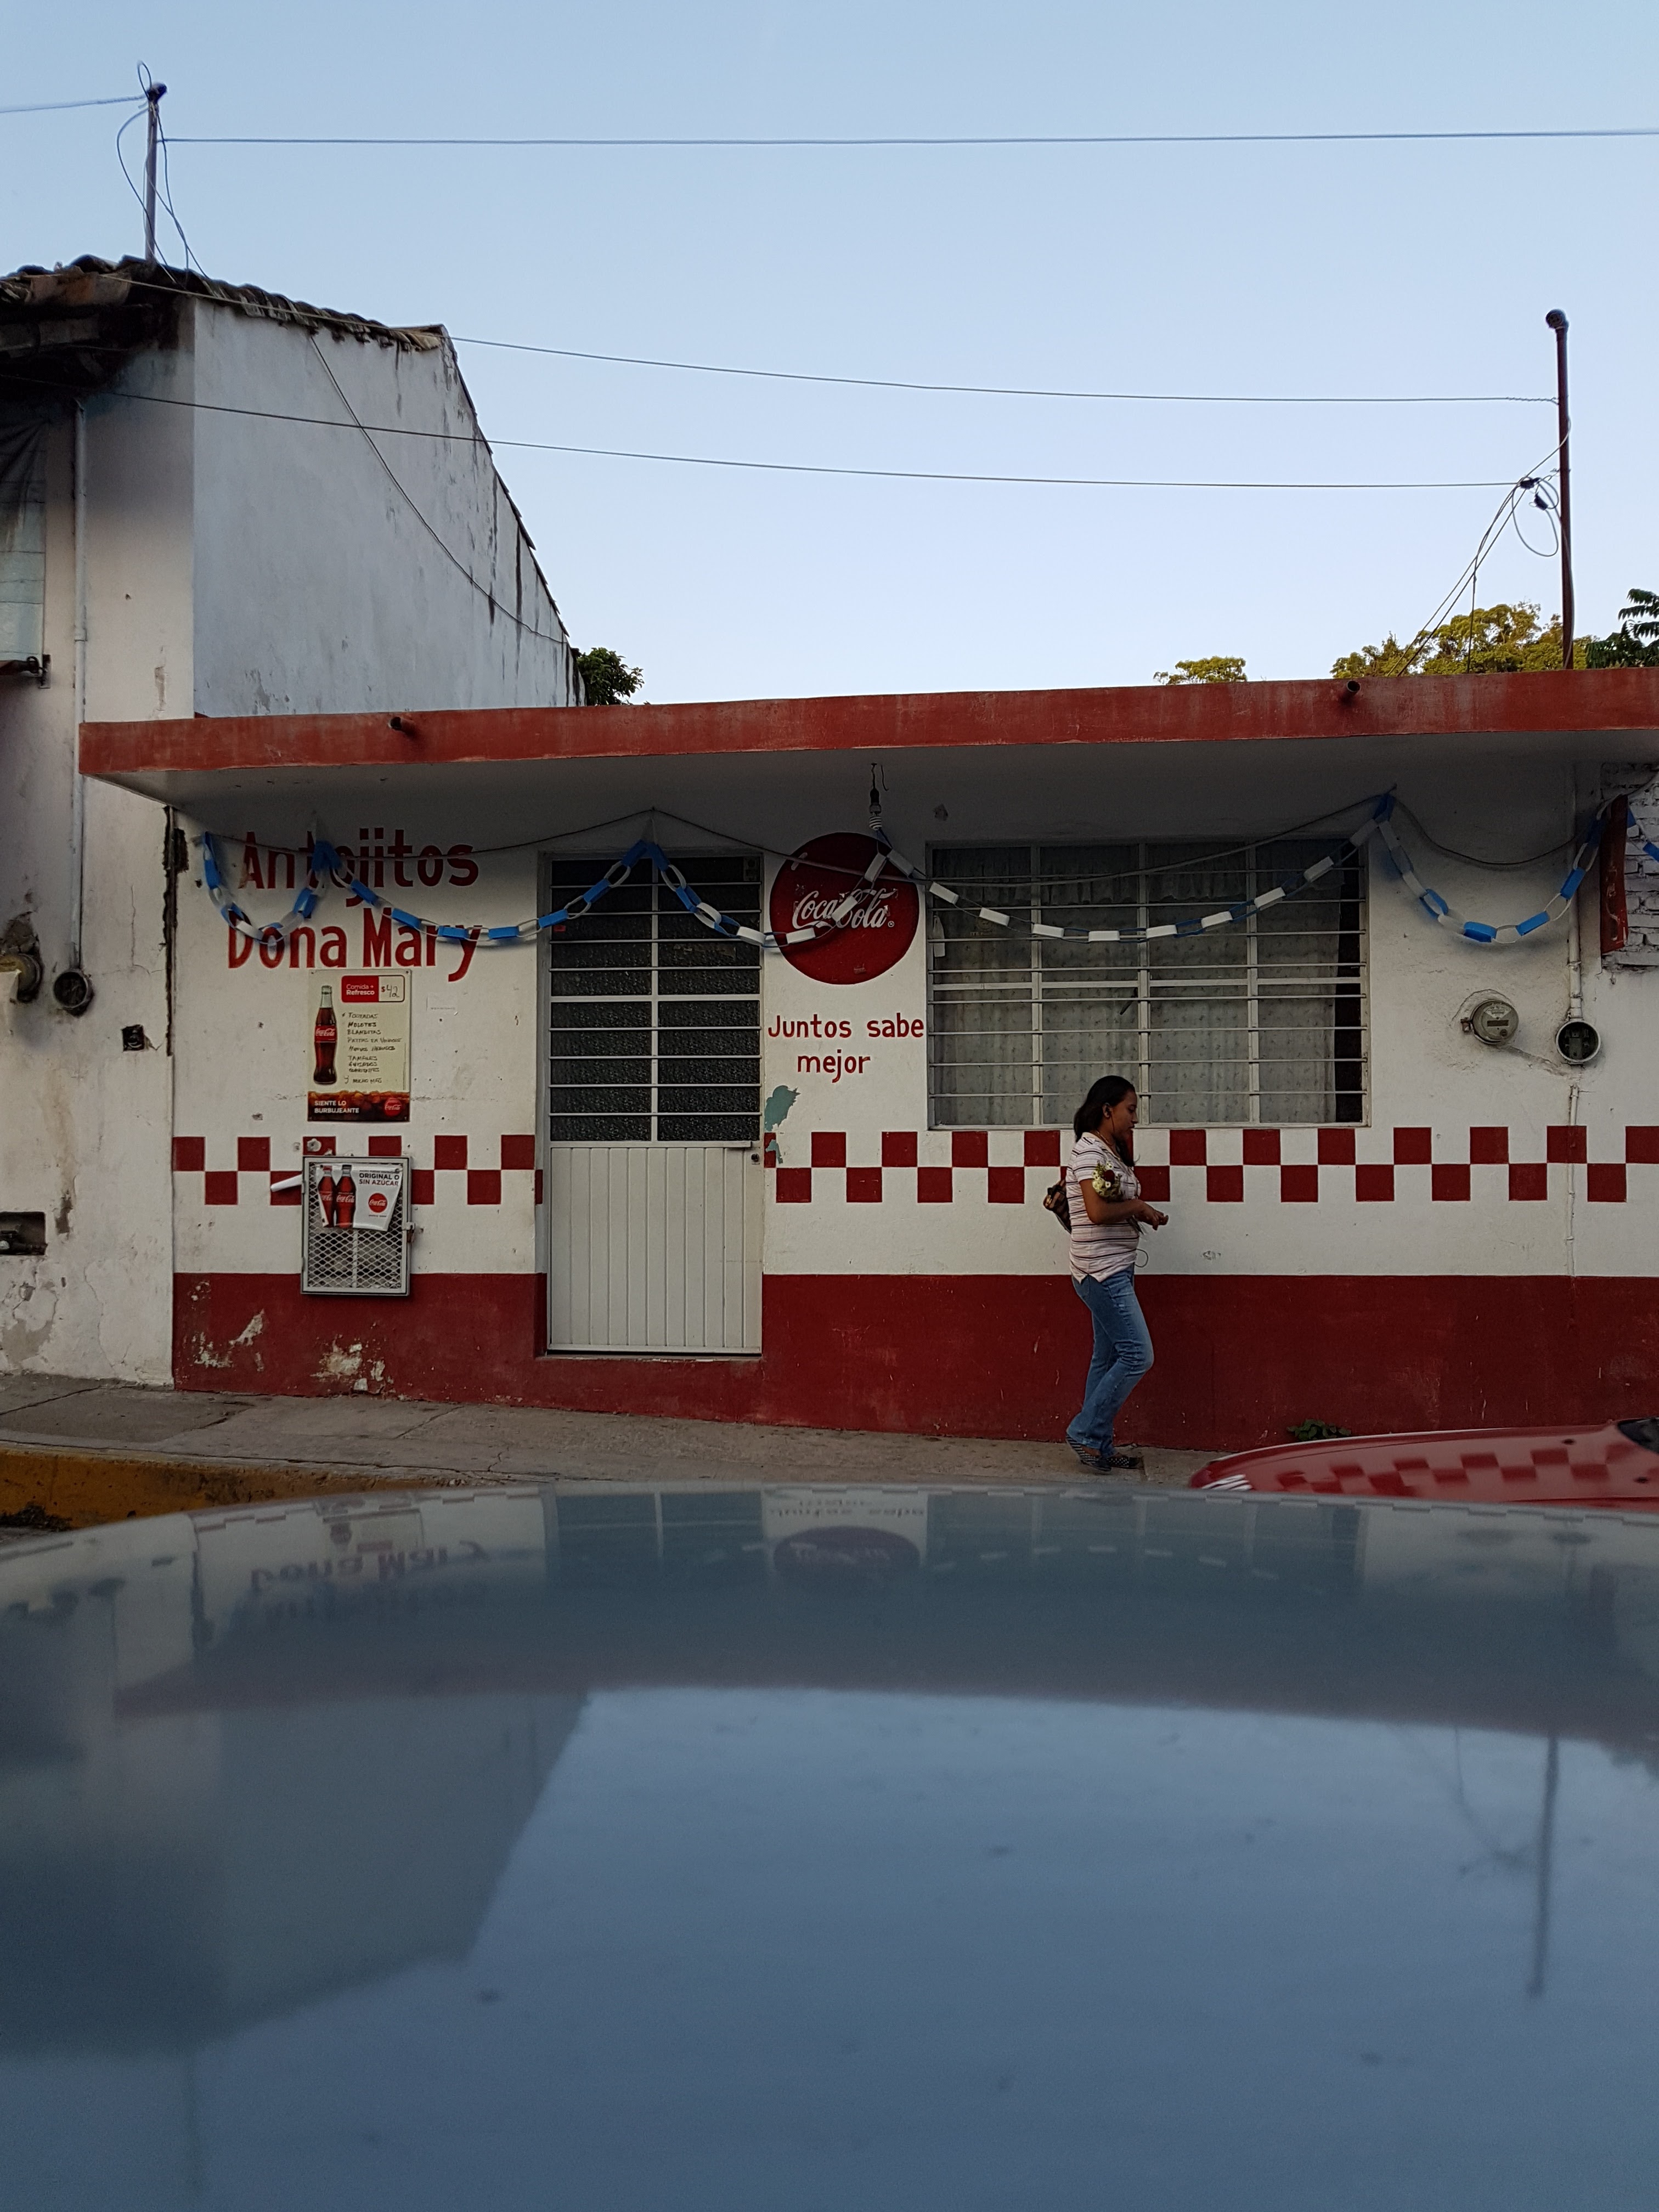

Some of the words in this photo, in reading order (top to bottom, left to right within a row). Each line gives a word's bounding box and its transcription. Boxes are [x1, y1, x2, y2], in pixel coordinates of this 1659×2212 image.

[792, 888, 898, 929] CocaCola
[363, 908, 483, 981] Mary
[768, 1014, 852, 1039] Juntos
[867, 1012, 924, 1038] sabe
[797, 1049, 871, 1083] mejor
